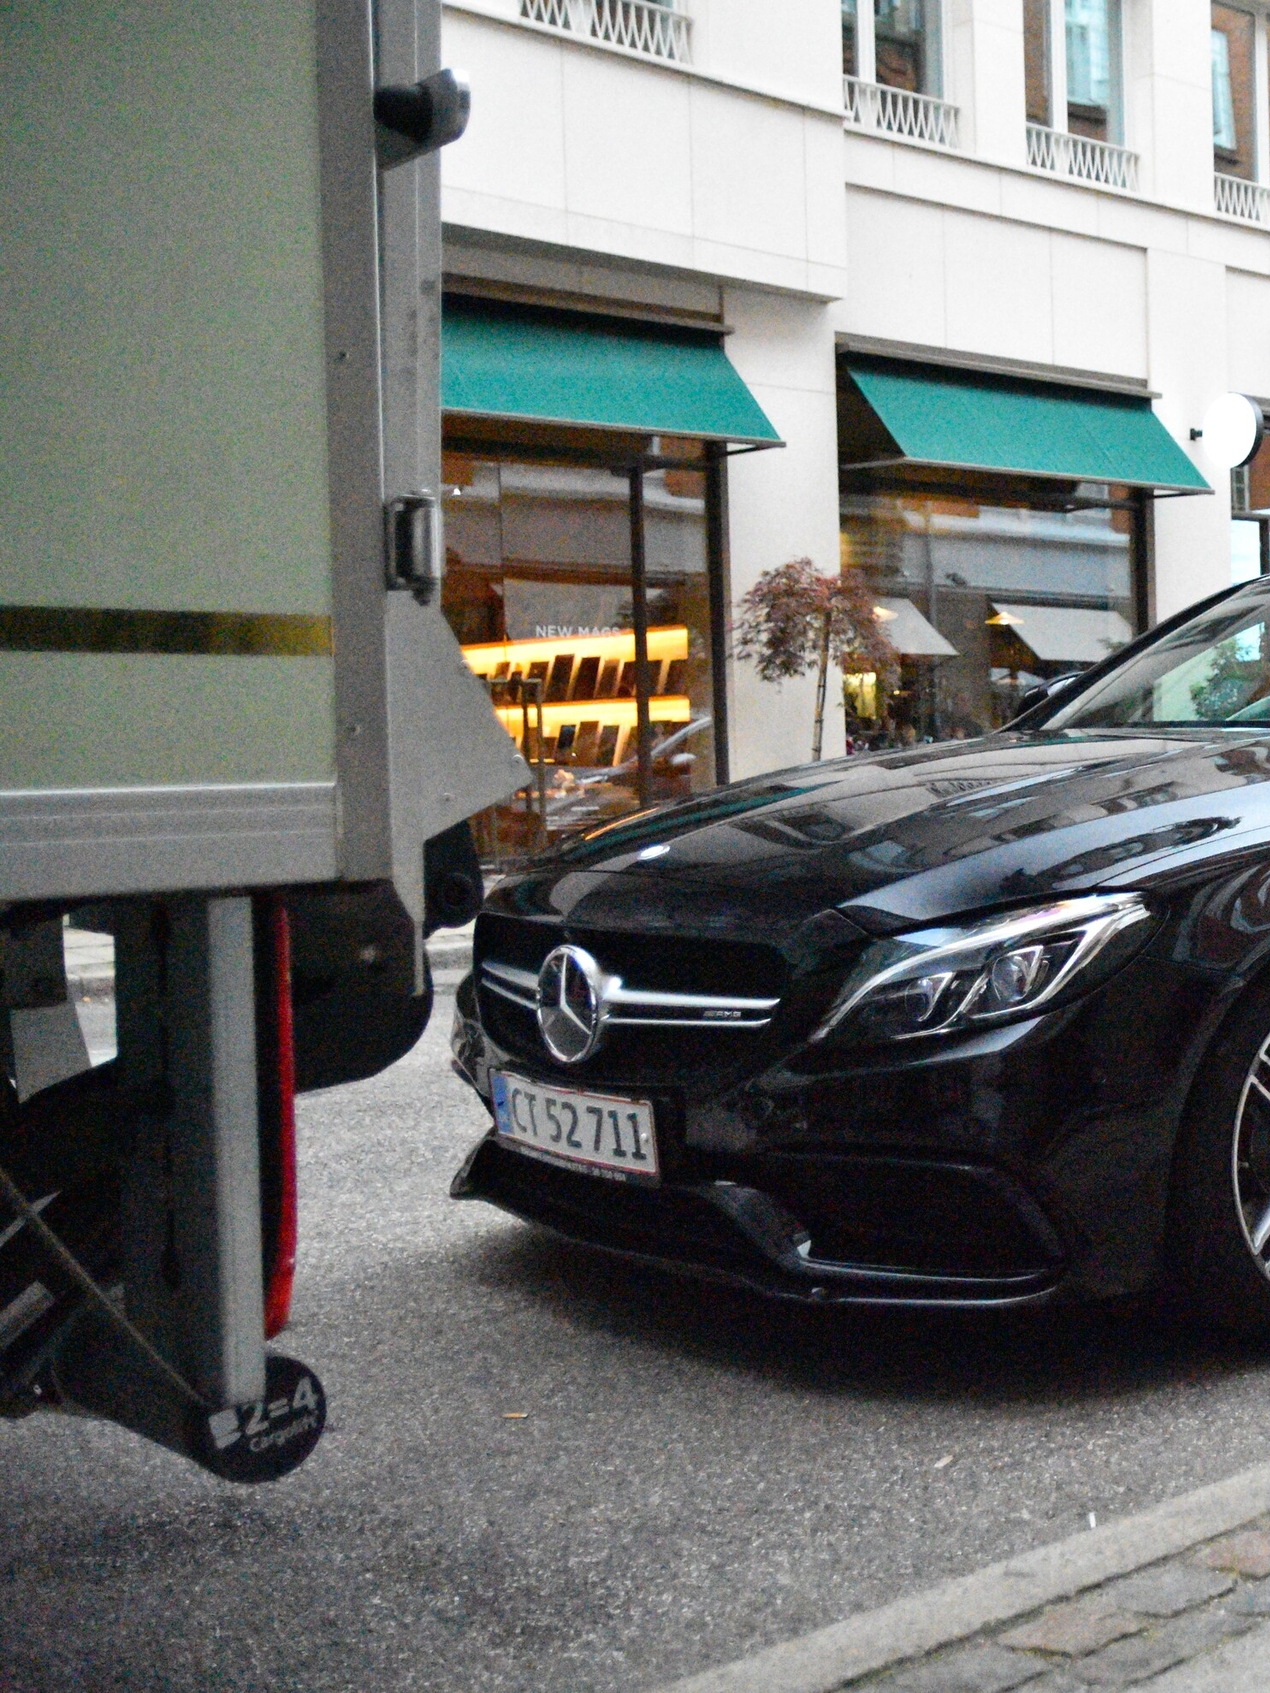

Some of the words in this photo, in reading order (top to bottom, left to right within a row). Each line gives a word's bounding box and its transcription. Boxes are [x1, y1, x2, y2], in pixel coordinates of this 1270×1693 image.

[535, 624, 573, 638] NEW
[577, 625, 621, 637] MAGS
[511, 1086, 538, 1137] CT
